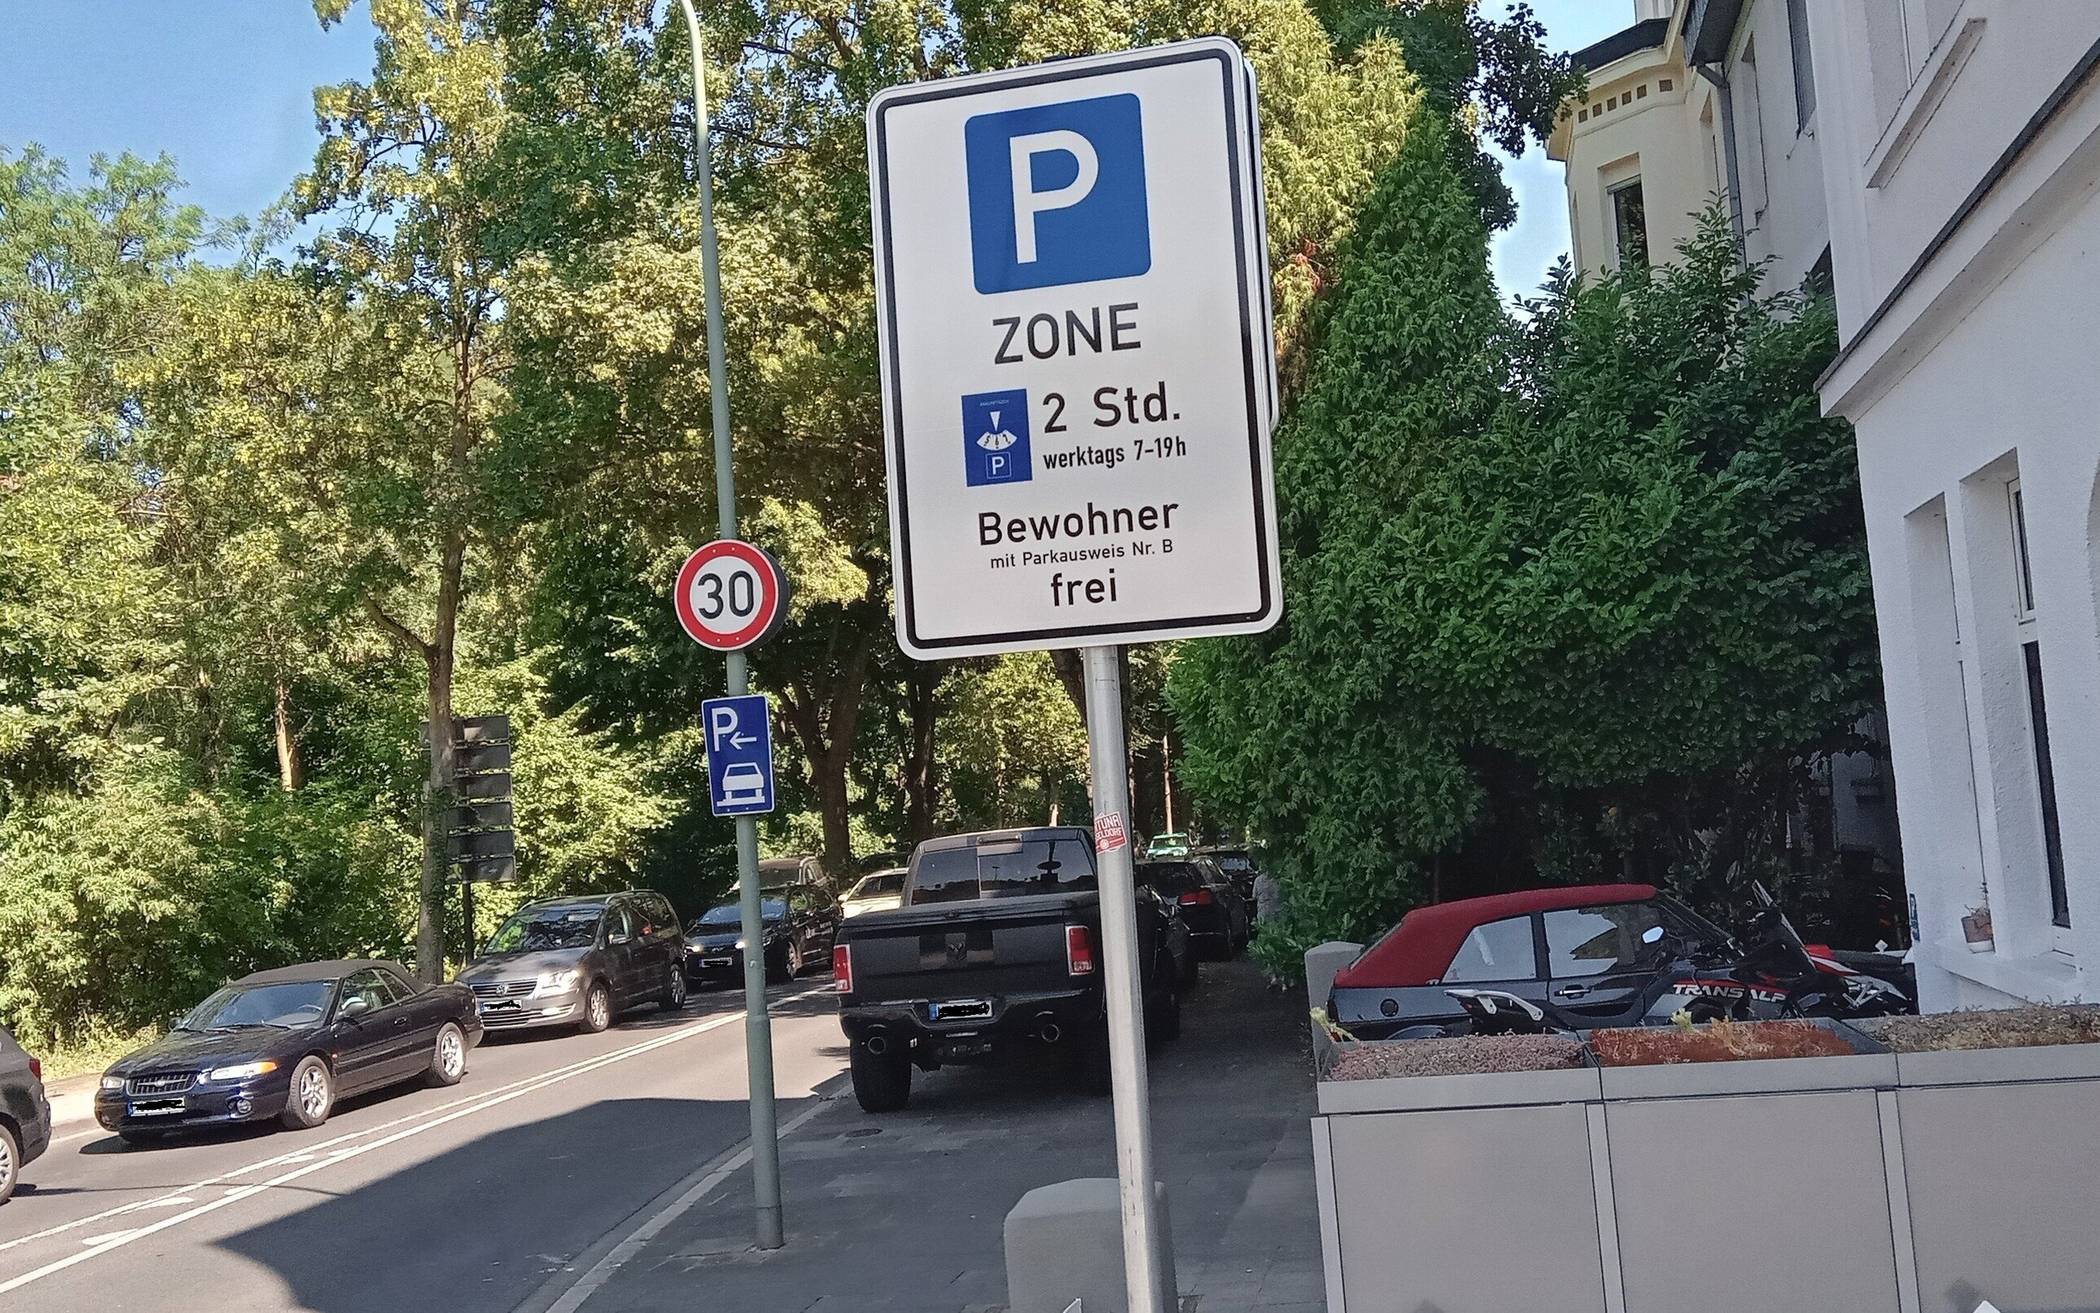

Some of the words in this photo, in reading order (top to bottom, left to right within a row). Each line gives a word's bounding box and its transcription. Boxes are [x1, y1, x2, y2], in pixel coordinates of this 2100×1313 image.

[1009, 128, 1099, 265] P
[992, 302, 1142, 364] ZONE
[1042, 392, 1068, 433] 2
[1092, 380, 1181, 428] Std.
[991, 456, 1005, 475] P
[1043, 444, 1126, 470] werktags
[978, 501, 1180, 546] Bewohner
[990, 553, 1016, 569] mit
[1022, 543, 1126, 566] Parkausweis
[1131, 540, 1156, 557] Nr.
[1162, 539, 1174, 554] B
[697, 570, 755, 620] 30
[1050, 568, 1118, 607] frei
[711, 706, 738, 752] P
